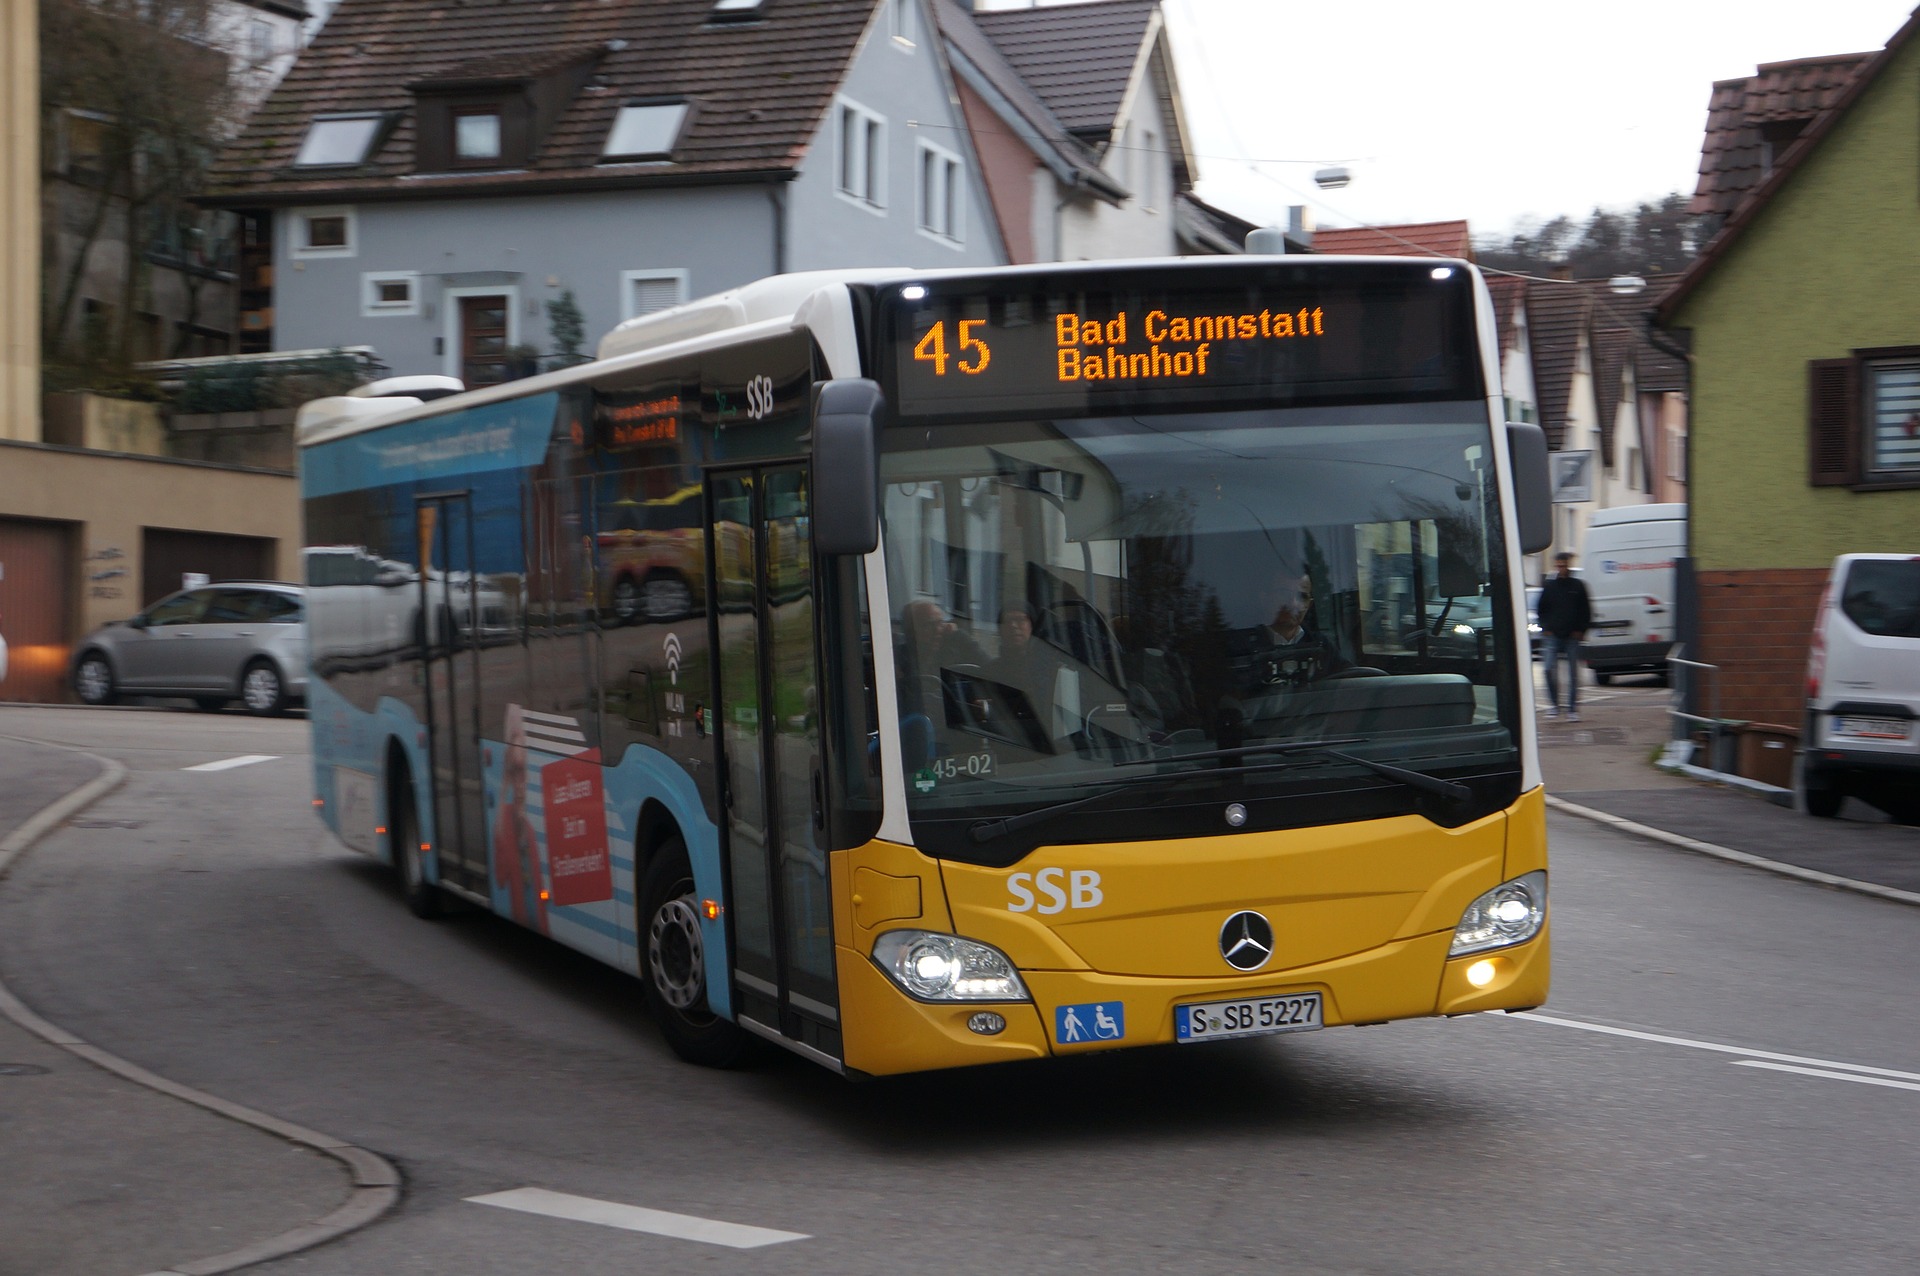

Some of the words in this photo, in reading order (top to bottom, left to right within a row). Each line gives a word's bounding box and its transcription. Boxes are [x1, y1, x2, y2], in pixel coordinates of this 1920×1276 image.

[1056, 312, 1127, 346] Bad
[1145, 307, 1324, 343] Cannstatt
[913, 319, 991, 376] 45
[1057, 342, 1210, 382] Bahnhof
[746, 374, 774, 420] SSB
[932, 754, 992, 779] 45-02
[1006, 867, 1104, 915] SSB
[1193, 1008, 1207, 1033] S
[1224, 1004, 1254, 1030] SB
[1259, 998, 1317, 1027] 5227
